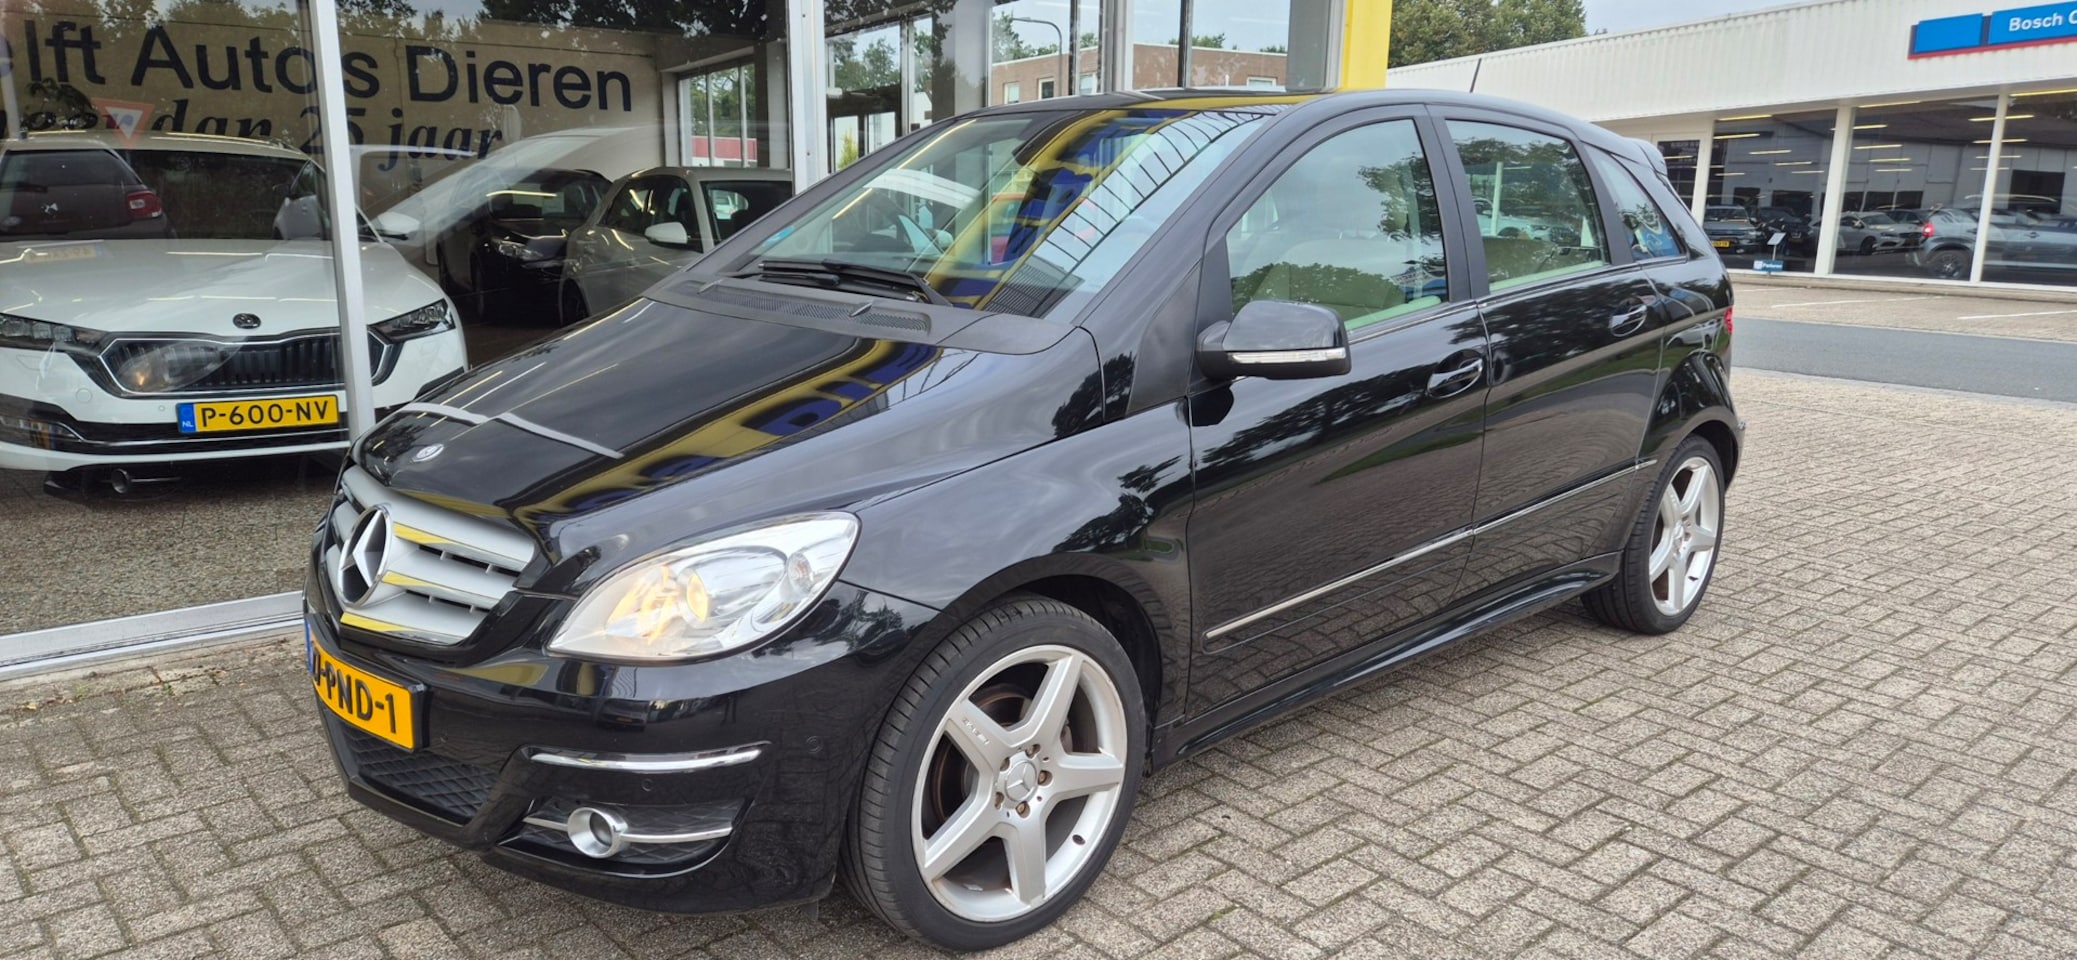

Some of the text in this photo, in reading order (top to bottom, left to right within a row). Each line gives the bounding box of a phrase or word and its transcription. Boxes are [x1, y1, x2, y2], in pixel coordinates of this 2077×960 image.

[2008, 12, 2063, 32] Bosch
[3, 19, 632, 112] lft Autos Dieren
[377, 107, 503, 172] jaar
[182, 400, 328, 428] NL P-600-NV
